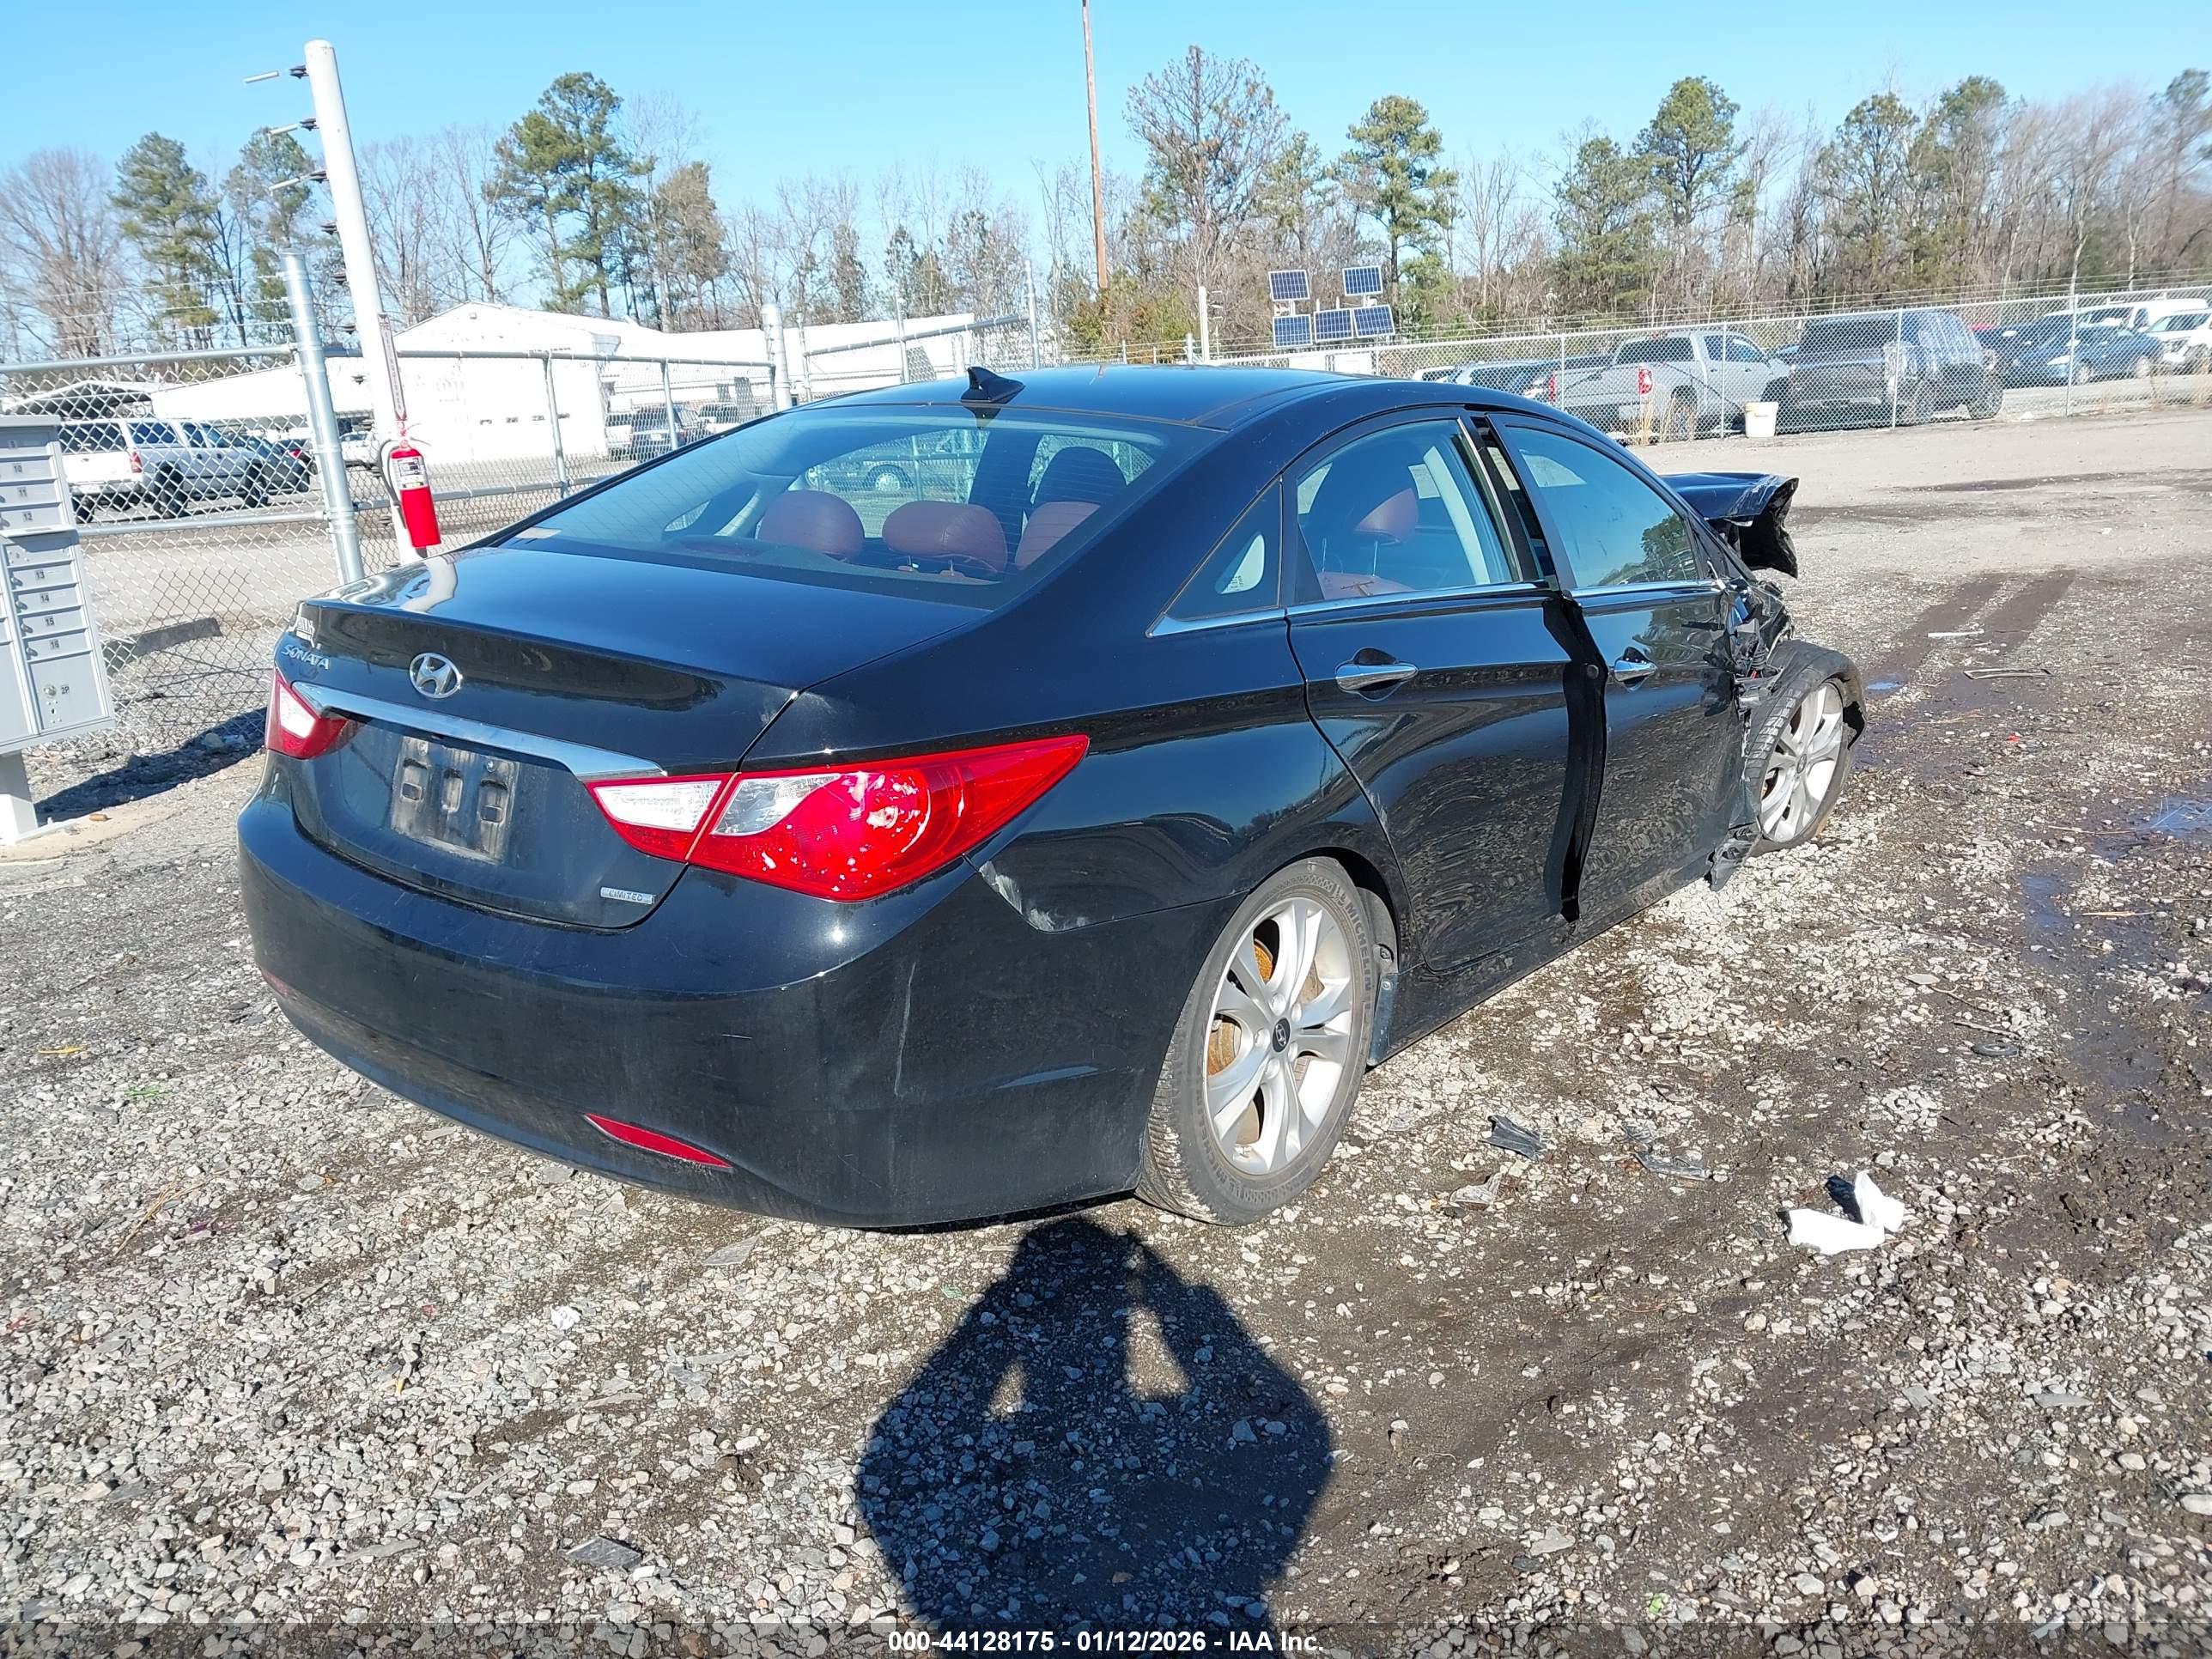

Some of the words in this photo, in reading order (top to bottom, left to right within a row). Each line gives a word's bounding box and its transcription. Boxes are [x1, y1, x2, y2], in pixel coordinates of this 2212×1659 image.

[14, 465, 22, 473] 10
[19, 489, 27, 497] 11
[36, 571, 46, 580] 13
[40, 593, 50, 602] 14
[46, 617, 55, 626] 15
[281, 644, 330, 670] SONATA
[61, 686, 70, 695] 2P
[610, 890, 643, 902] LIMITED
[1345, 902, 1372, 992] MICHELIN
